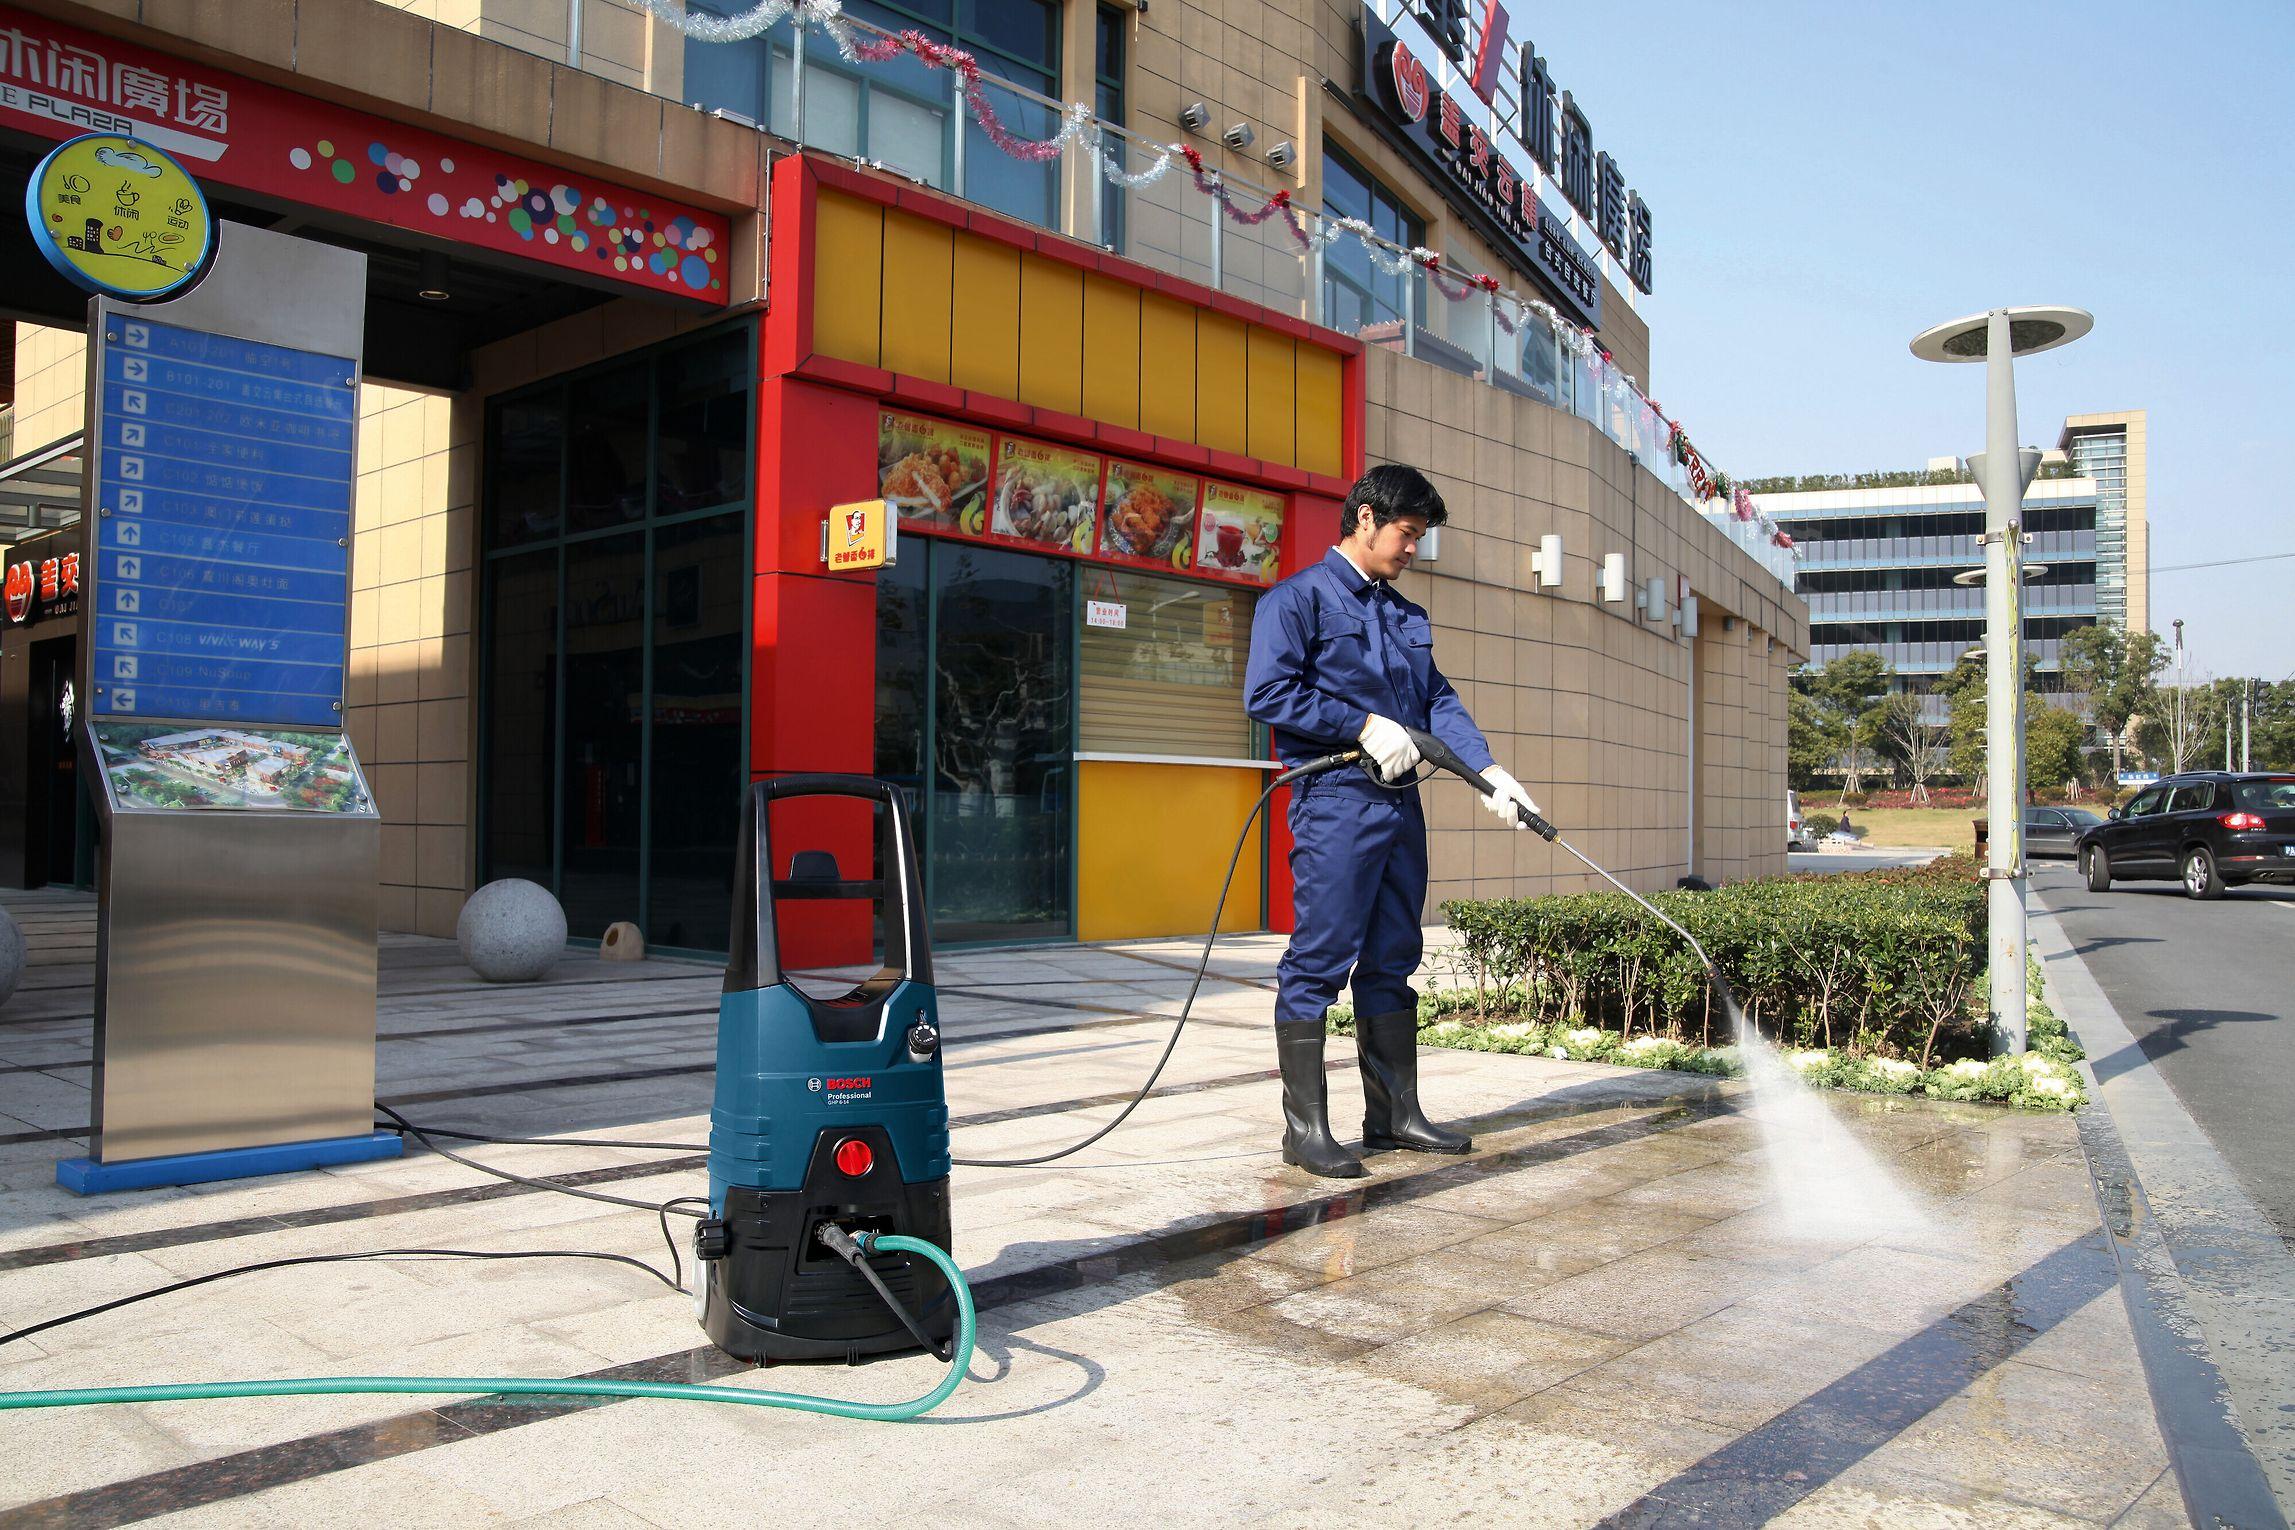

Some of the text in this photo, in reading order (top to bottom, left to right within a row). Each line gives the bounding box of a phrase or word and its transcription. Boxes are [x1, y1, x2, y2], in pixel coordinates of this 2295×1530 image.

[29, 94, 133, 135] PLAZA
[58, 194, 81, 205] 美食
[1474, 179, 1494, 206] JIAO
[1495, 200, 1511, 224] YUN
[114, 205, 139, 220] 休闲
[167, 216, 189, 229] 运动
[166, 371, 230, 390] B101-201
[157, 632, 192, 645] C108
[826, 1077, 871, 1090] BOSCH
[828, 1091, 872, 1100] Professional
